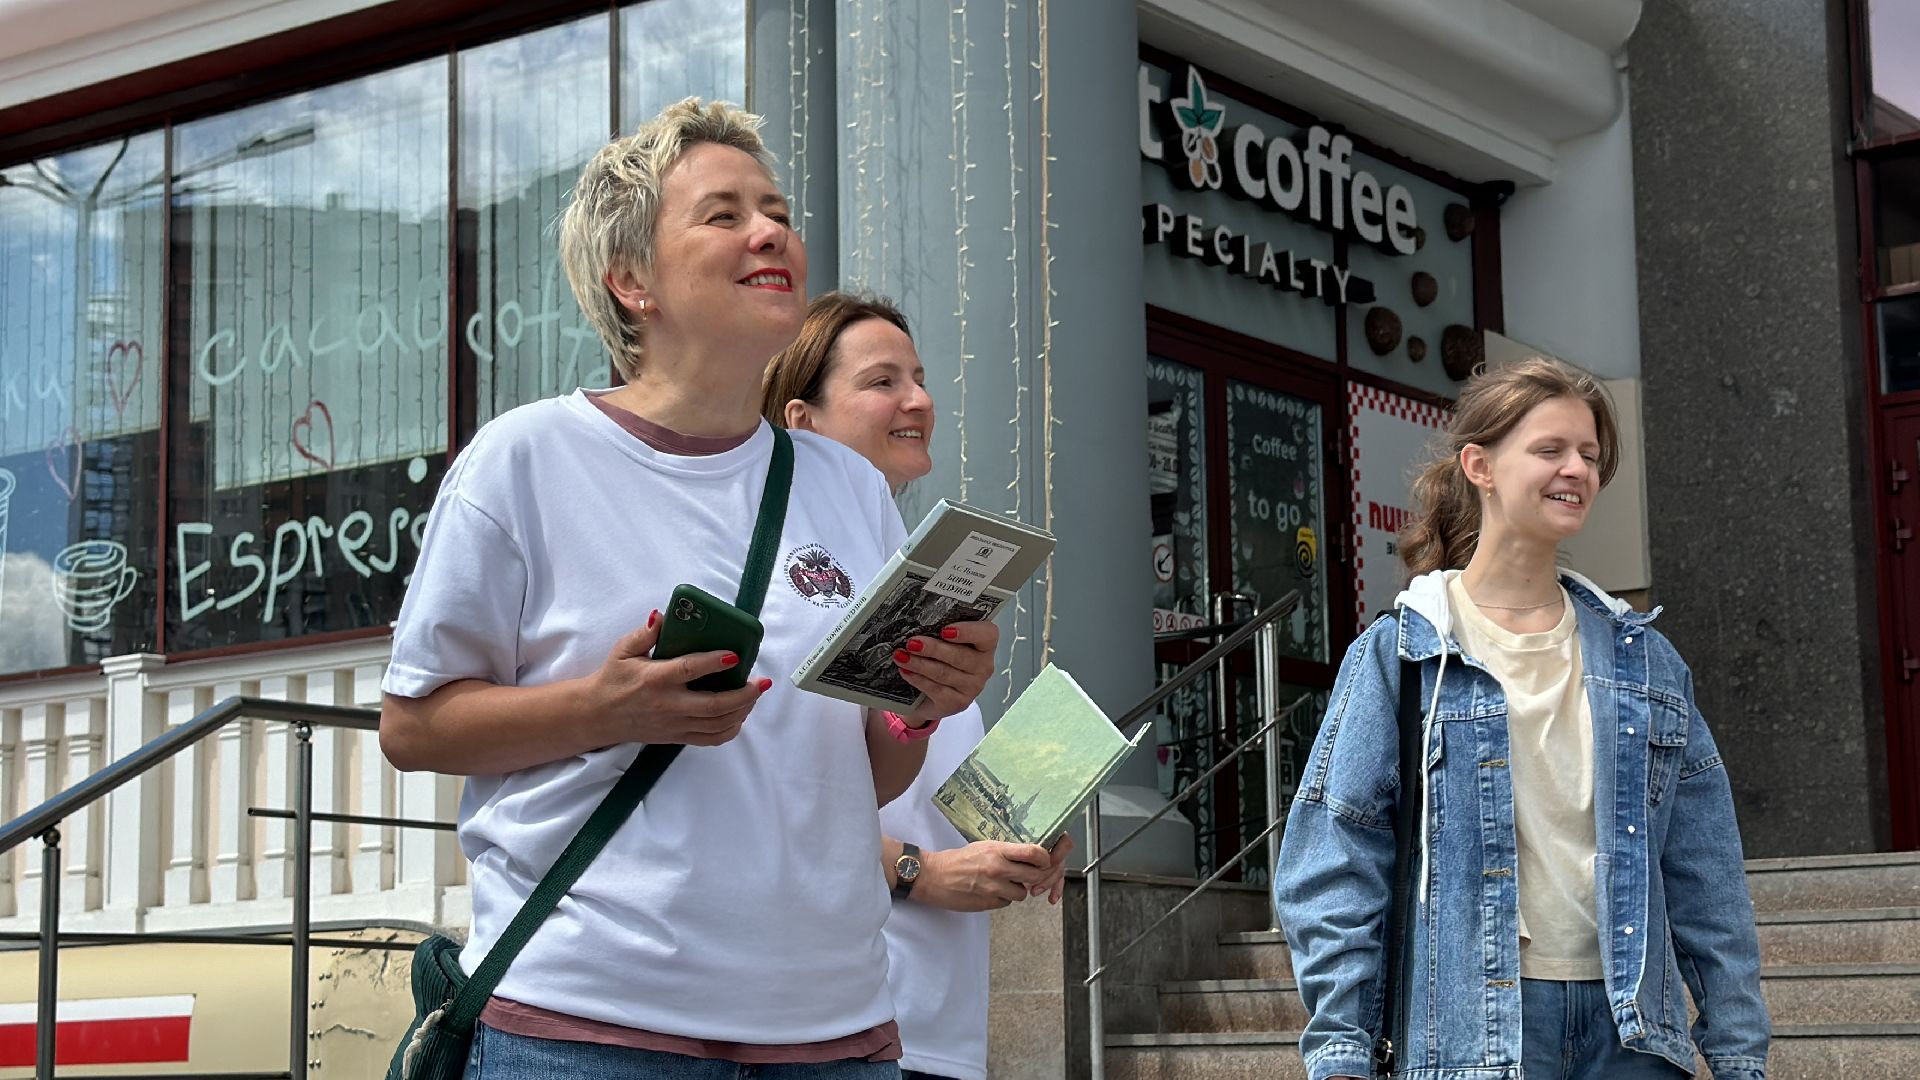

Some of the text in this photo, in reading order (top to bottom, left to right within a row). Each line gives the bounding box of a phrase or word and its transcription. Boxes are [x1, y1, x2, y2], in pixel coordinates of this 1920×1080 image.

[1233, 123, 1418, 255] coffee
[1141, 203, 1351, 304] PECIALTY
[1252, 433, 1297, 461] Coffee
[1247, 489, 1301, 533] to go
[934, 581, 973, 597] ГОДУНОВ
